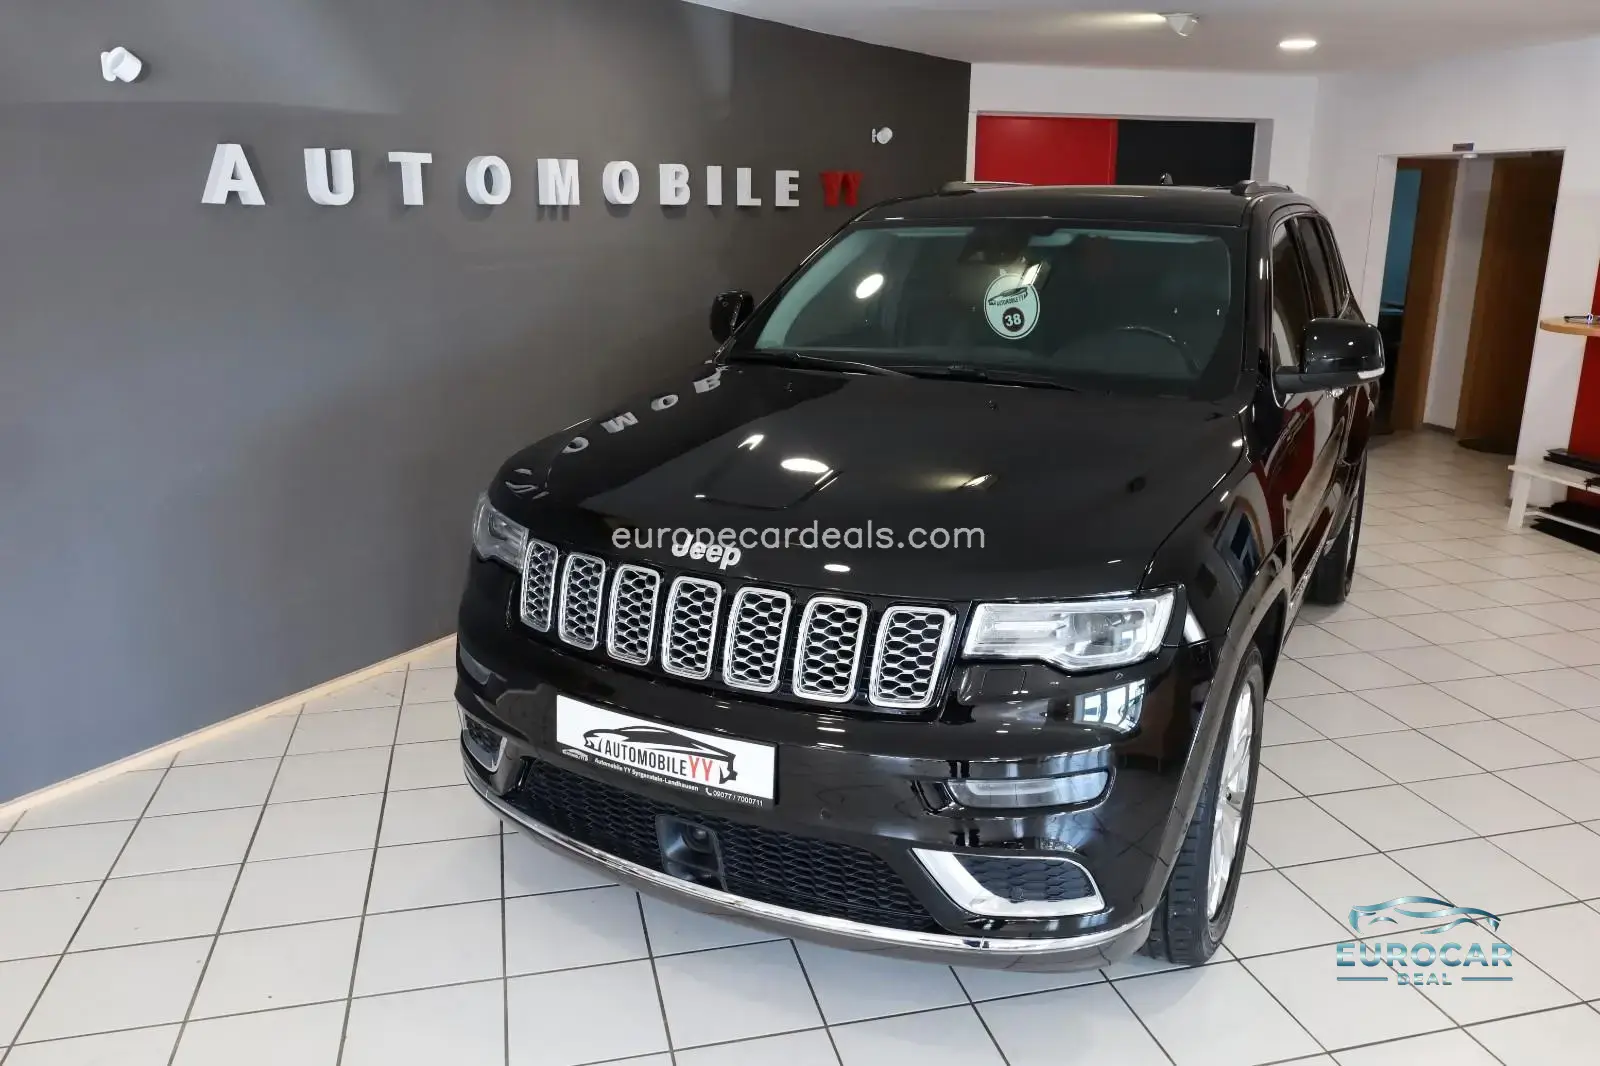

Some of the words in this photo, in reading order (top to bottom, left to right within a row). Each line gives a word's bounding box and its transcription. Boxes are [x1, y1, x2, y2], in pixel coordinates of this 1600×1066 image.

[201, 143, 800, 207] AUTOMOBILE
[819, 170, 865, 207] YY
[1004, 313, 1022, 327] 38
[671, 533, 742, 570] Jeep
[737, 796, 763, 806] 7000711
